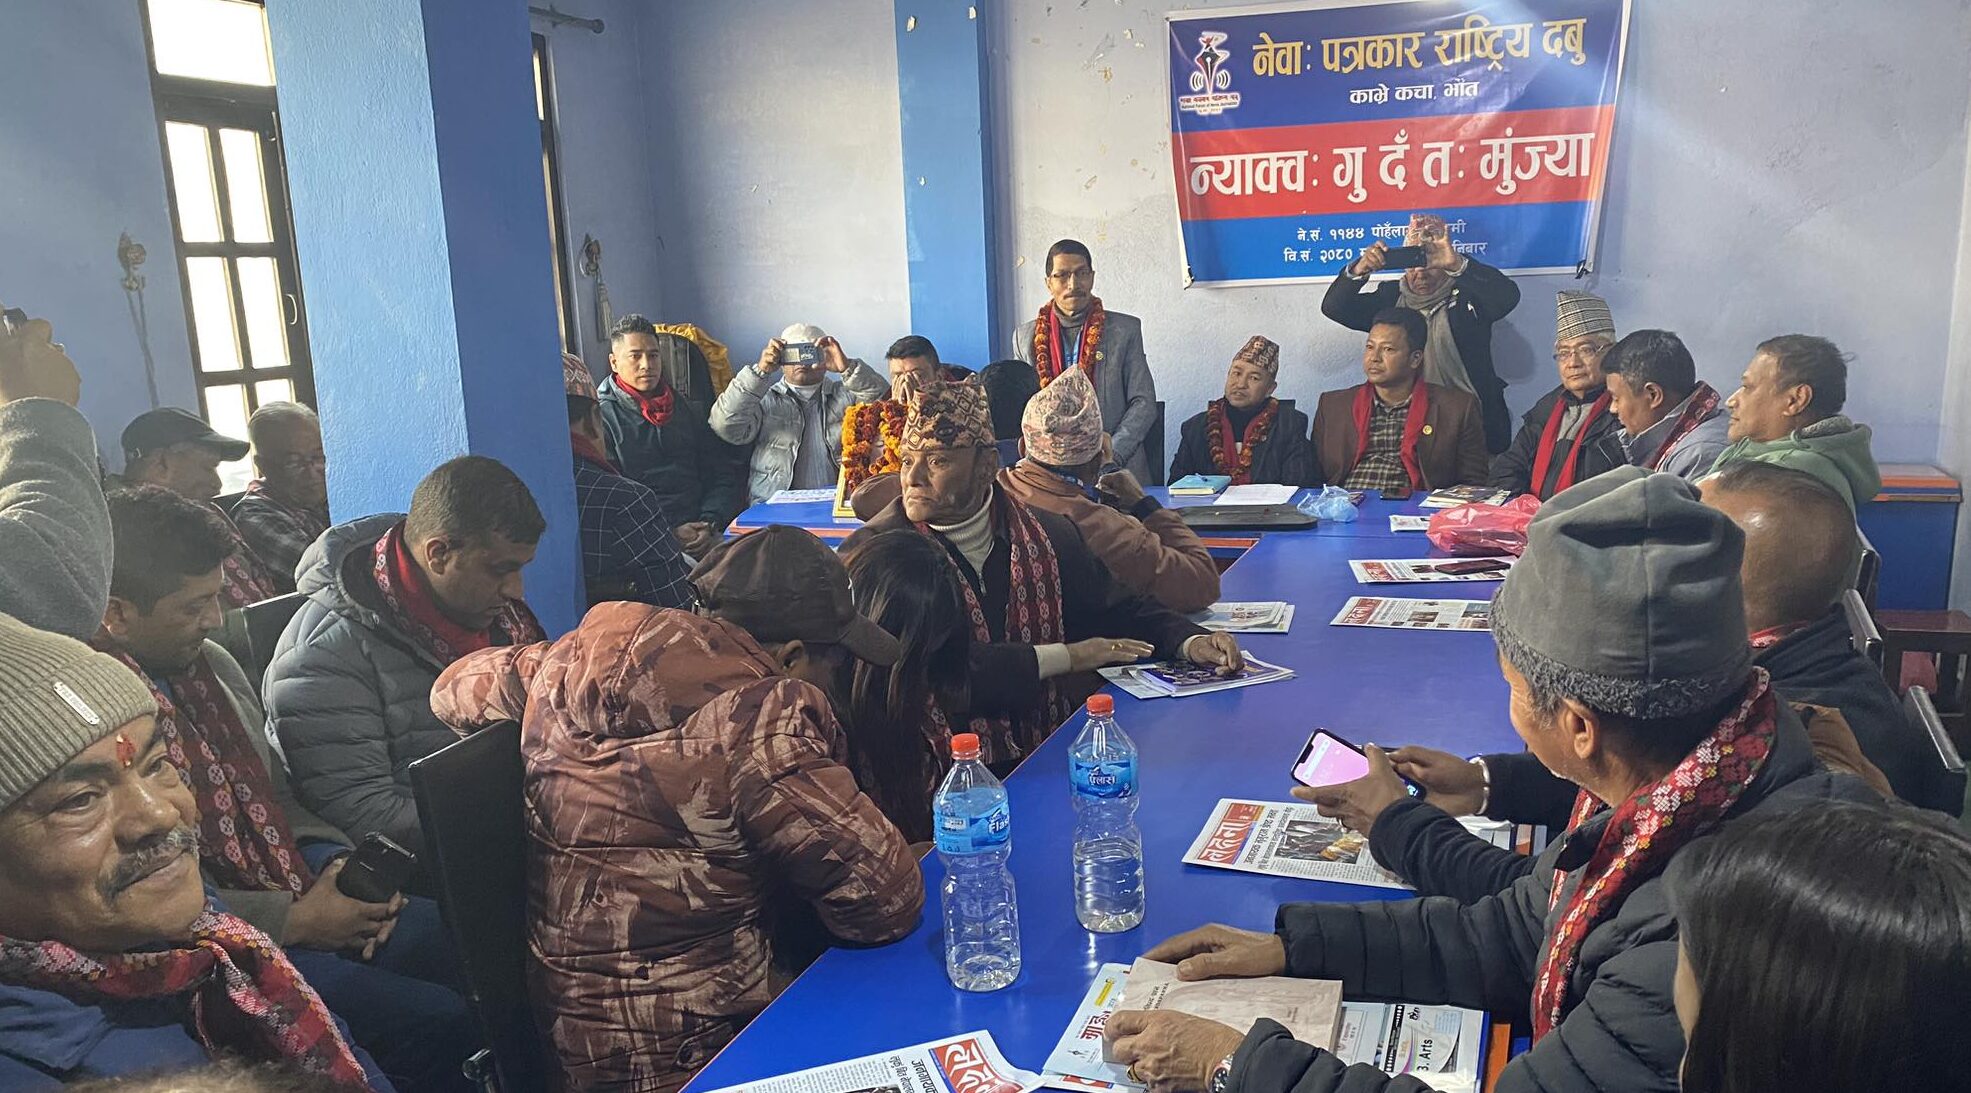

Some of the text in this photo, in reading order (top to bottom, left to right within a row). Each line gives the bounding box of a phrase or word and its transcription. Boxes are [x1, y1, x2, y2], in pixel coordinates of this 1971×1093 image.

[1321, 32, 1426, 73] पत्रकार
[1332, 146, 1368, 203] गु
[1479, 127, 1596, 195] मुंज्या
[1329, 227, 1365, 240] ११४४
[1320, 247, 1353, 263] २०८०
[1418, 1039, 1434, 1060] Arts
